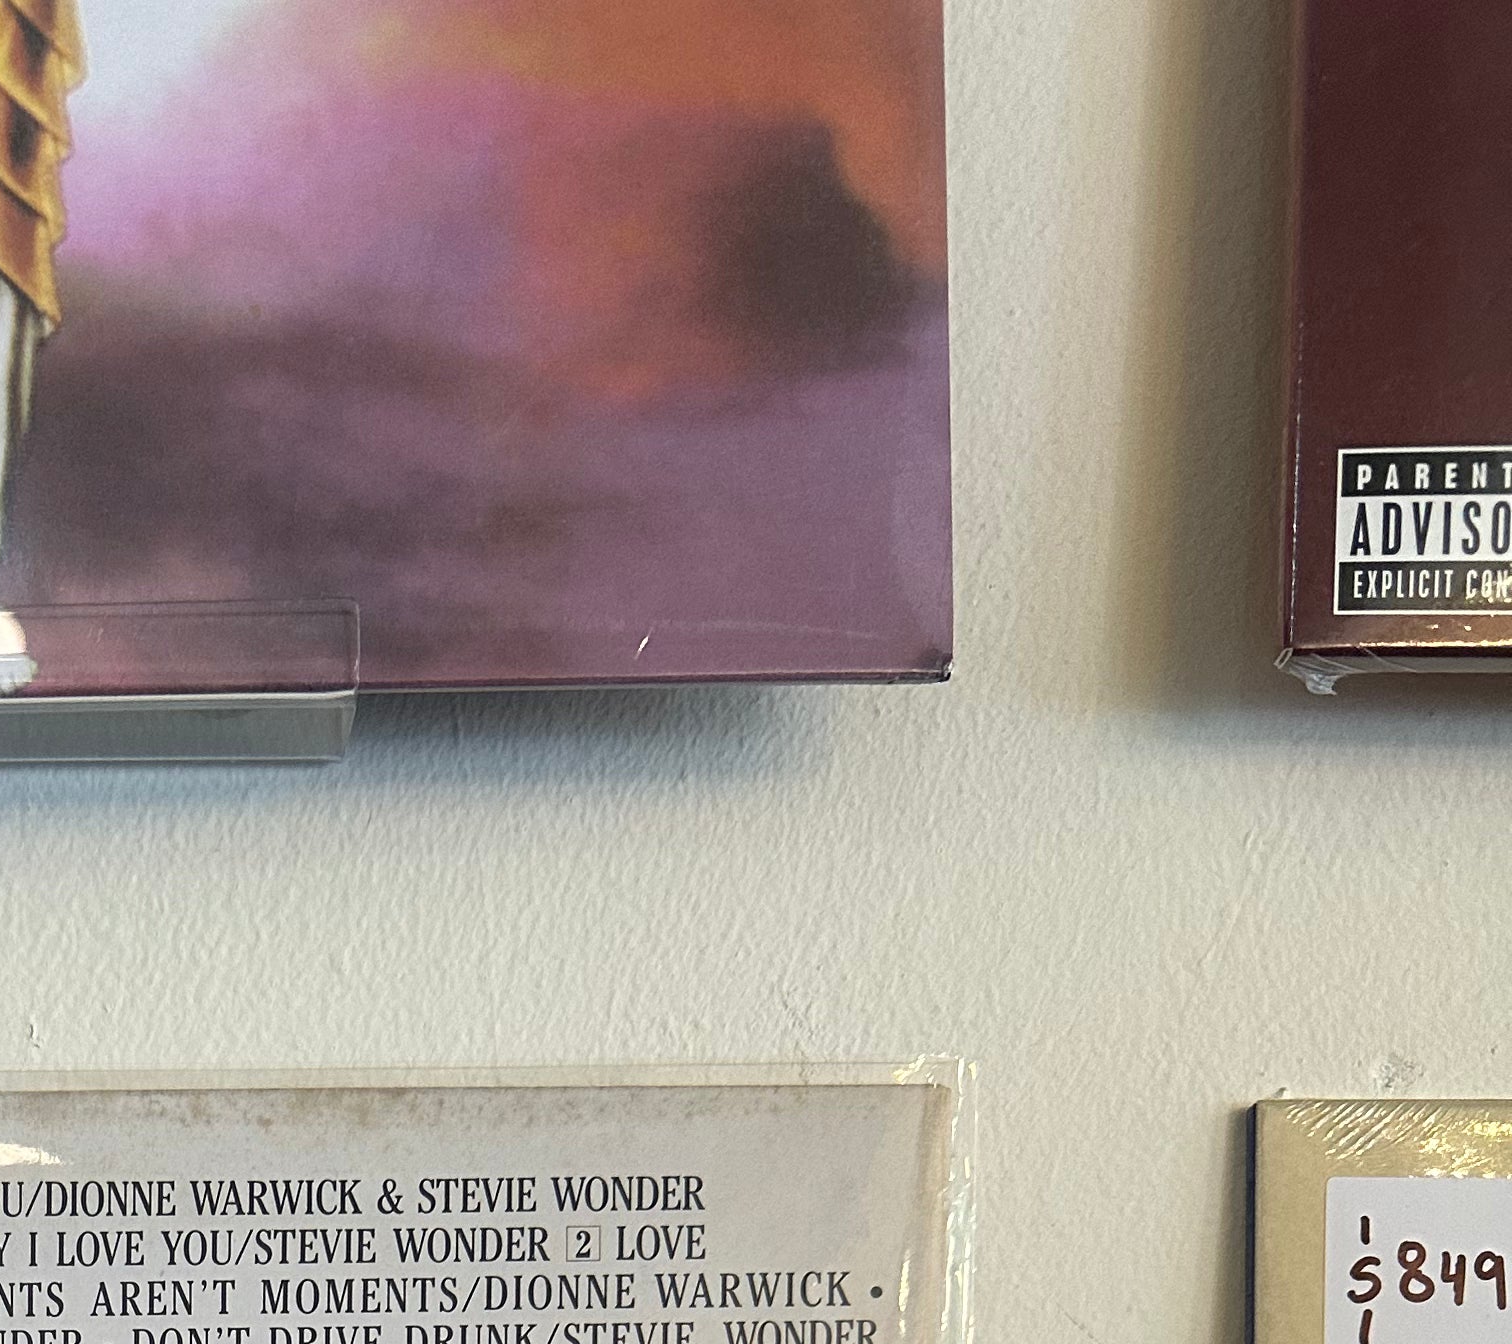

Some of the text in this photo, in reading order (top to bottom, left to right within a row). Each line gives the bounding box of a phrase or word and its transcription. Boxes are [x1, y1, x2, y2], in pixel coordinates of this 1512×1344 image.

[1350, 501, 1511, 556] ADVISO
[1354, 570, 1454, 599] EXPLICIT
[190, 1179, 362, 1216] WARWICK
[377, 1179, 404, 1214] &
[418, 1177, 536, 1214] STEVIE
[550, 1175, 705, 1212] WONDER
[29, 1232, 37, 1266] I
[57, 1231, 144, 1267] LOVE
[161, 1228, 376, 1266] YOU/STEVIE
[393, 1227, 550, 1263] WONDER
[616, 1225, 705, 1260] LOVE
[90, 1280, 235, 1316] AREN'T
[261, 1274, 635, 1314] MOMENTS/DIONNE
[655, 1271, 851, 1308] WARWICK
